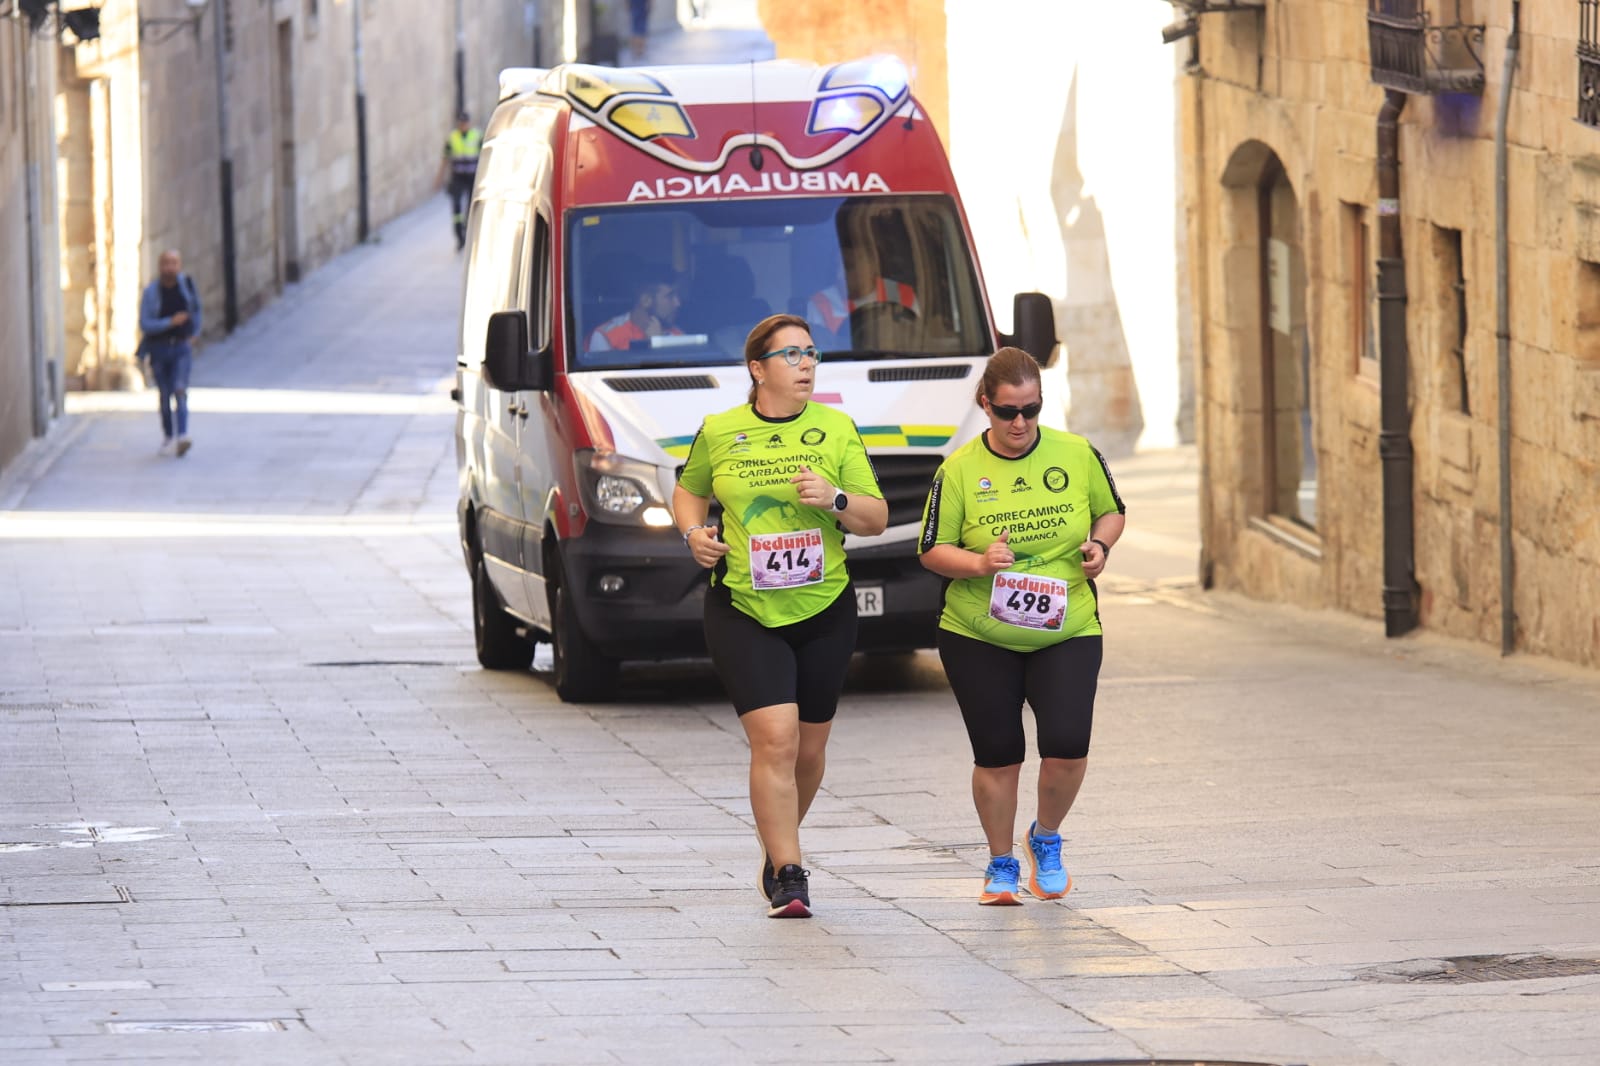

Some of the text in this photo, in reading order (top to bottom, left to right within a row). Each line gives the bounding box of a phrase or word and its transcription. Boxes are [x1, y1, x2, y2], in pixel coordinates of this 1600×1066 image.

[729, 454, 824, 471] CORRECAMINOS
[749, 478, 792, 488] SALAMAN
[978, 503, 1075, 526] CORRECAMINOS
[991, 516, 1068, 537] CARBAJOSA
[751, 534, 822, 553] bedunia
[767, 548, 810, 572] 414
[995, 574, 1066, 597] bedunia
[1006, 590, 1051, 614] 498
